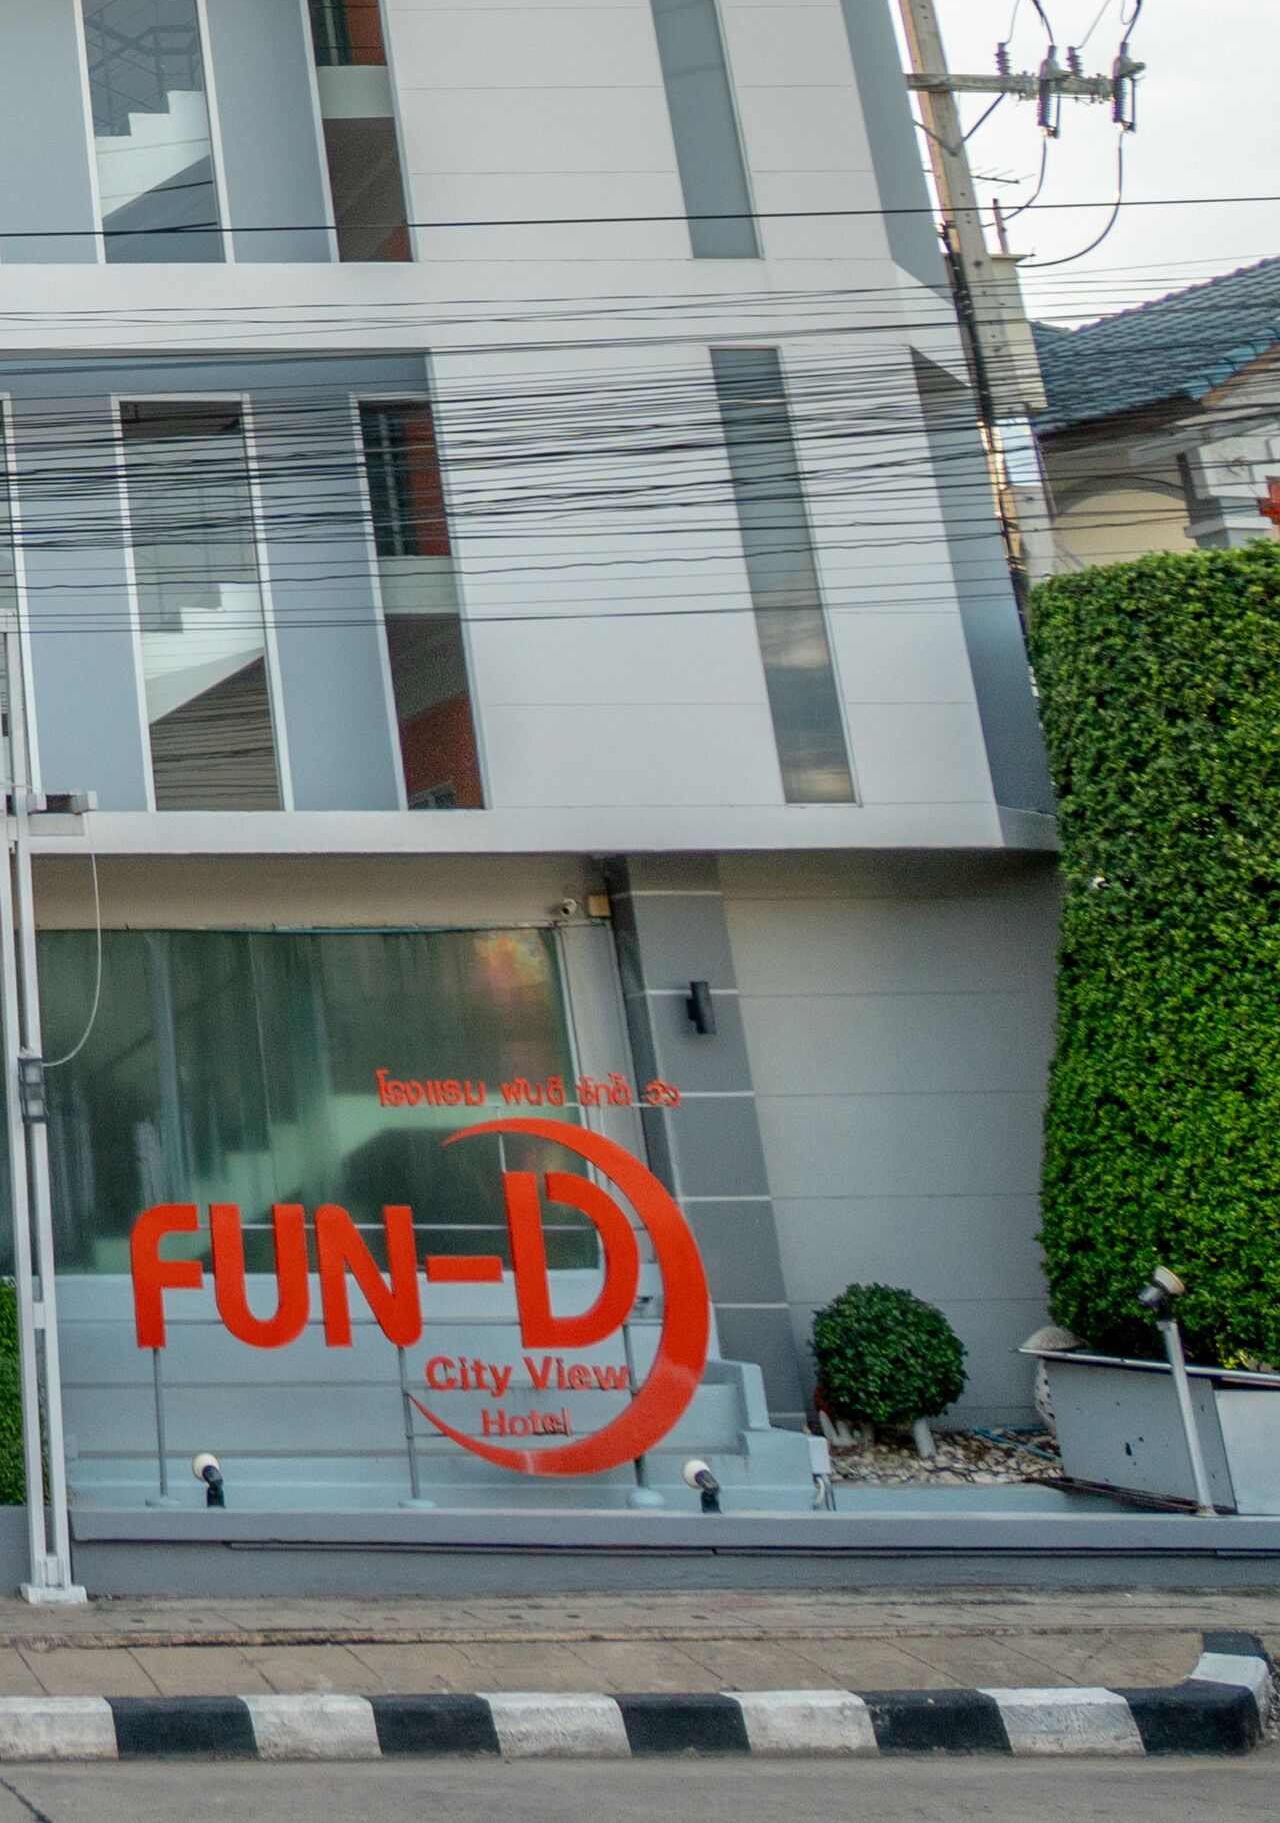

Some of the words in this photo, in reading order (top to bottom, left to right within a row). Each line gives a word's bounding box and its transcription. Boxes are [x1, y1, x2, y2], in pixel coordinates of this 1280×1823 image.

[375, 1069, 487, 1107] โรงแรม
[130, 1171, 641, 1350] FUN-D
[425, 1356, 513, 1401] City
[523, 1355, 630, 1391] View
[482, 1408, 571, 1438] Hotel
